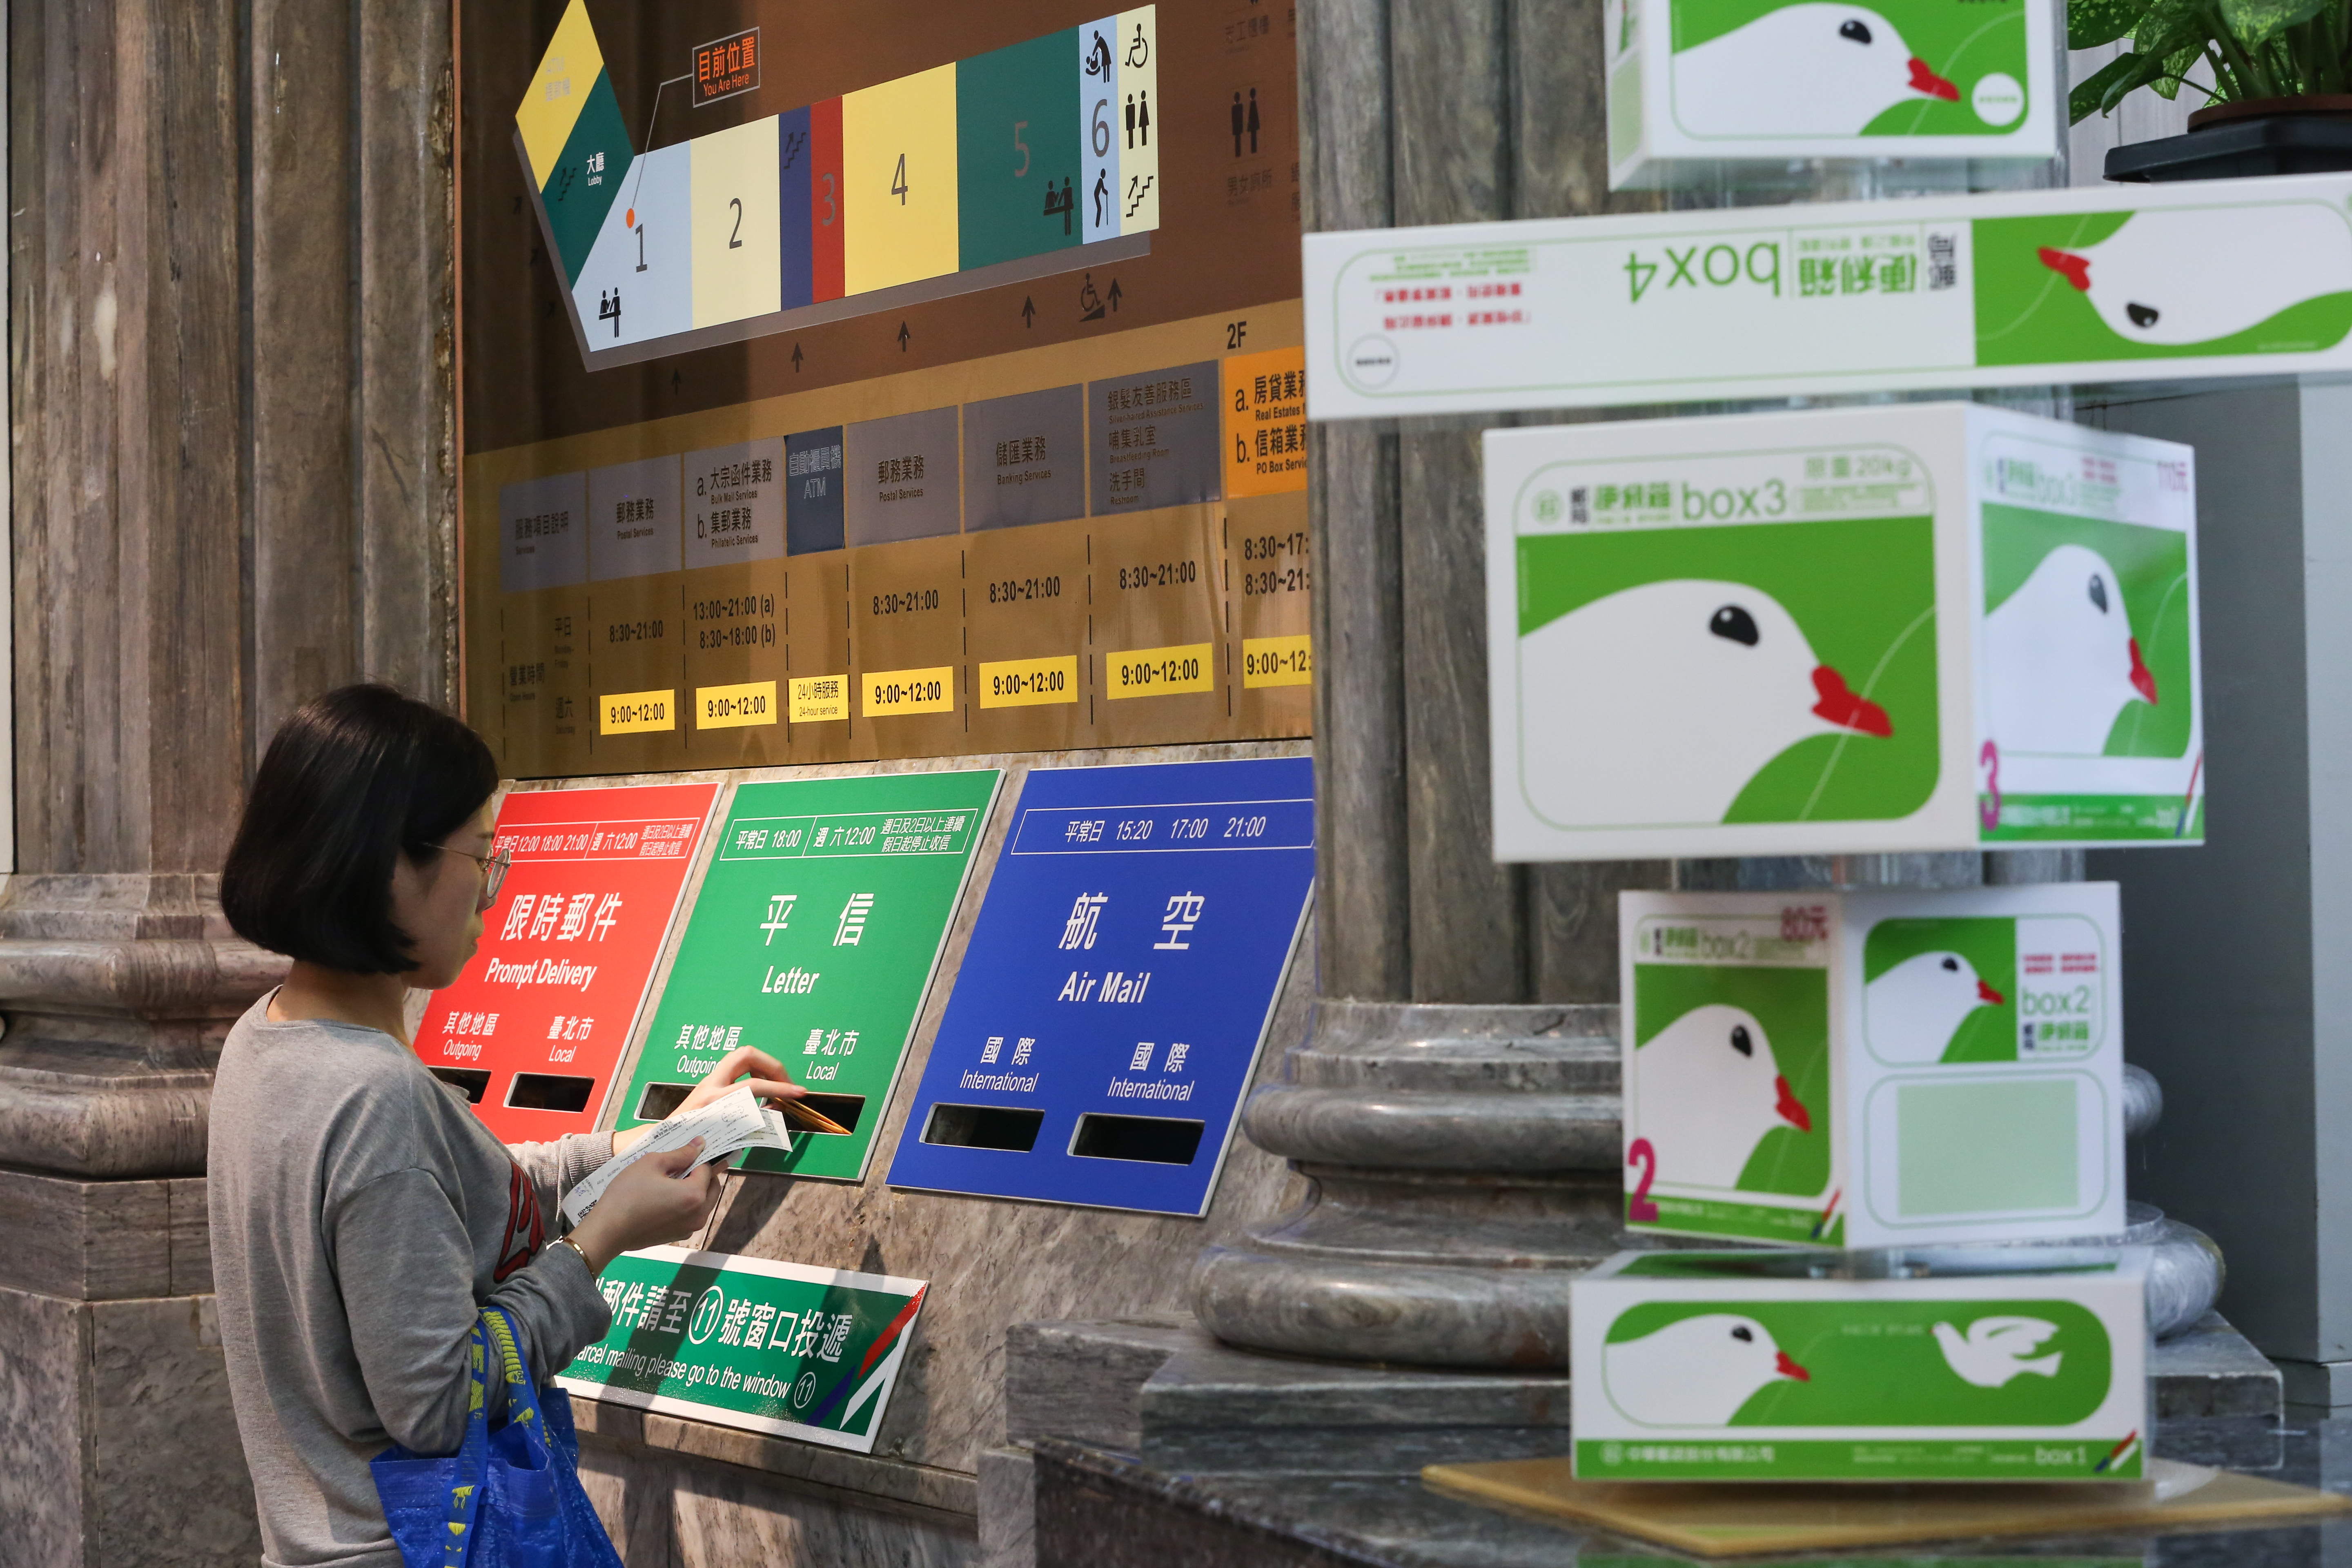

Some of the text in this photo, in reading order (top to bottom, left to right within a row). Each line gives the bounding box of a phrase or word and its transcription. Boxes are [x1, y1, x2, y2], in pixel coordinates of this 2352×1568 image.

[699, 37, 755, 82] 目前位置
[704, 74, 749, 96] You Are Here
[1092, 99, 1109, 157] 6
[1015, 120, 1030, 177] 5
[587, 152, 604, 174] 大廳
[588, 175, 602, 186] Lobby
[891, 154, 908, 205] 4
[820, 172, 837, 227] 3
[729, 198, 742, 249] 2
[636, 224, 647, 272] 1
[1624, 242, 1781, 305] box4
[1227, 321, 1246, 350] 2F
[1107, 377, 1192, 410] 銀髮友善服務區
[1109, 403, 1204, 424] Silver-haired Assistance Services
[1256, 409, 1271, 421] Real
[1274, 406, 1300, 418] Estates
[1108, 424, 1156, 450] 哺集乳室
[788, 444, 842, 477] 自動櫃員機
[996, 436, 1045, 466] 儲匯業務
[1110, 447, 1169, 464] Breastfeeding Room
[710, 459, 772, 490] 大宗函件業務
[878, 455, 924, 484] 郵務業務
[998, 470, 1051, 485] Banking Services
[1110, 468, 1144, 491] 洗手間
[1257, 462, 1267, 474] PO
[1270, 461, 1283, 473] Box
[711, 490, 757, 504] Bulk Mail Services
[803, 477, 826, 499] ATM
[880, 489, 923, 501] Postal Services
[1111, 496, 1138, 505] Restroom
[1681, 478, 1787, 522] box3
[710, 507, 751, 534] 集郵業務
[617, 529, 632, 539] Postal
[712, 534, 758, 548] Philatelic Services
[1120, 561, 1196, 589] 8:30~21:00
[873, 590, 938, 615] 8:30~21:00
[990, 576, 1060, 603] 8:30~21:00
[694, 594, 774, 620] 13:00~21:00 (a)
[610, 620, 663, 643] 8:30~21:00
[700, 624, 775, 649] 8:30~18:00 (b)
[994, 671, 1063, 695] 9:00~12:00
[1122, 659, 1198, 685] 9:00~12:00
[798, 682, 838, 699] 24小時服務
[875, 681, 940, 704] 9:00~12:00
[611, 703, 664, 723] 9:00~12:00
[708, 696, 765, 717] 9:00~12:00
[800, 704, 838, 716] 24-hour service
[1979, 739, 2000, 832] 3
[640, 823, 694, 840] 週日及2日以上連續
[880, 816, 966, 834] 週日及2日以上連續
[1065, 816, 1266, 842] 平常日 15:20 17:00 21:00
[518, 835, 540, 851] 12:00
[541, 834, 563, 851] 18:00
[563, 833, 589, 851] 21:00
[615, 832, 638, 850] 12:00
[639, 840, 682, 857] 假日起停止收信
[736, 830, 768, 850] 平常日
[772, 830, 801, 847] 18:00
[845, 827, 875, 845] 12:00
[882, 835, 951, 852] 假日起停止收信
[500, 893, 622, 941] 限時郵件
[484, 958, 597, 992] Prompt Delivery
[762, 966, 820, 993] Letter
[1058, 971, 1151, 1002] Air Mail
[2022, 984, 2089, 1016] box2
[442, 1011, 594, 1040] 其他地區 臺北市
[444, 1039, 576, 1062] Outgoing Local
[673, 1023, 859, 1056] 其他地區 臺北市
[806, 1061, 839, 1080] Local
[960, 1069, 1194, 1100] International International
[1627, 1136, 1659, 1222] 2
[574, 1343, 608, 1365] arcel
[605, 1348, 647, 1377] mailing
[645, 1354, 688, 1379] please
[686, 1365, 704, 1387] go
[705, 1364, 719, 1385] to
[720, 1366, 741, 1389] the
[743, 1372, 791, 1401] window
